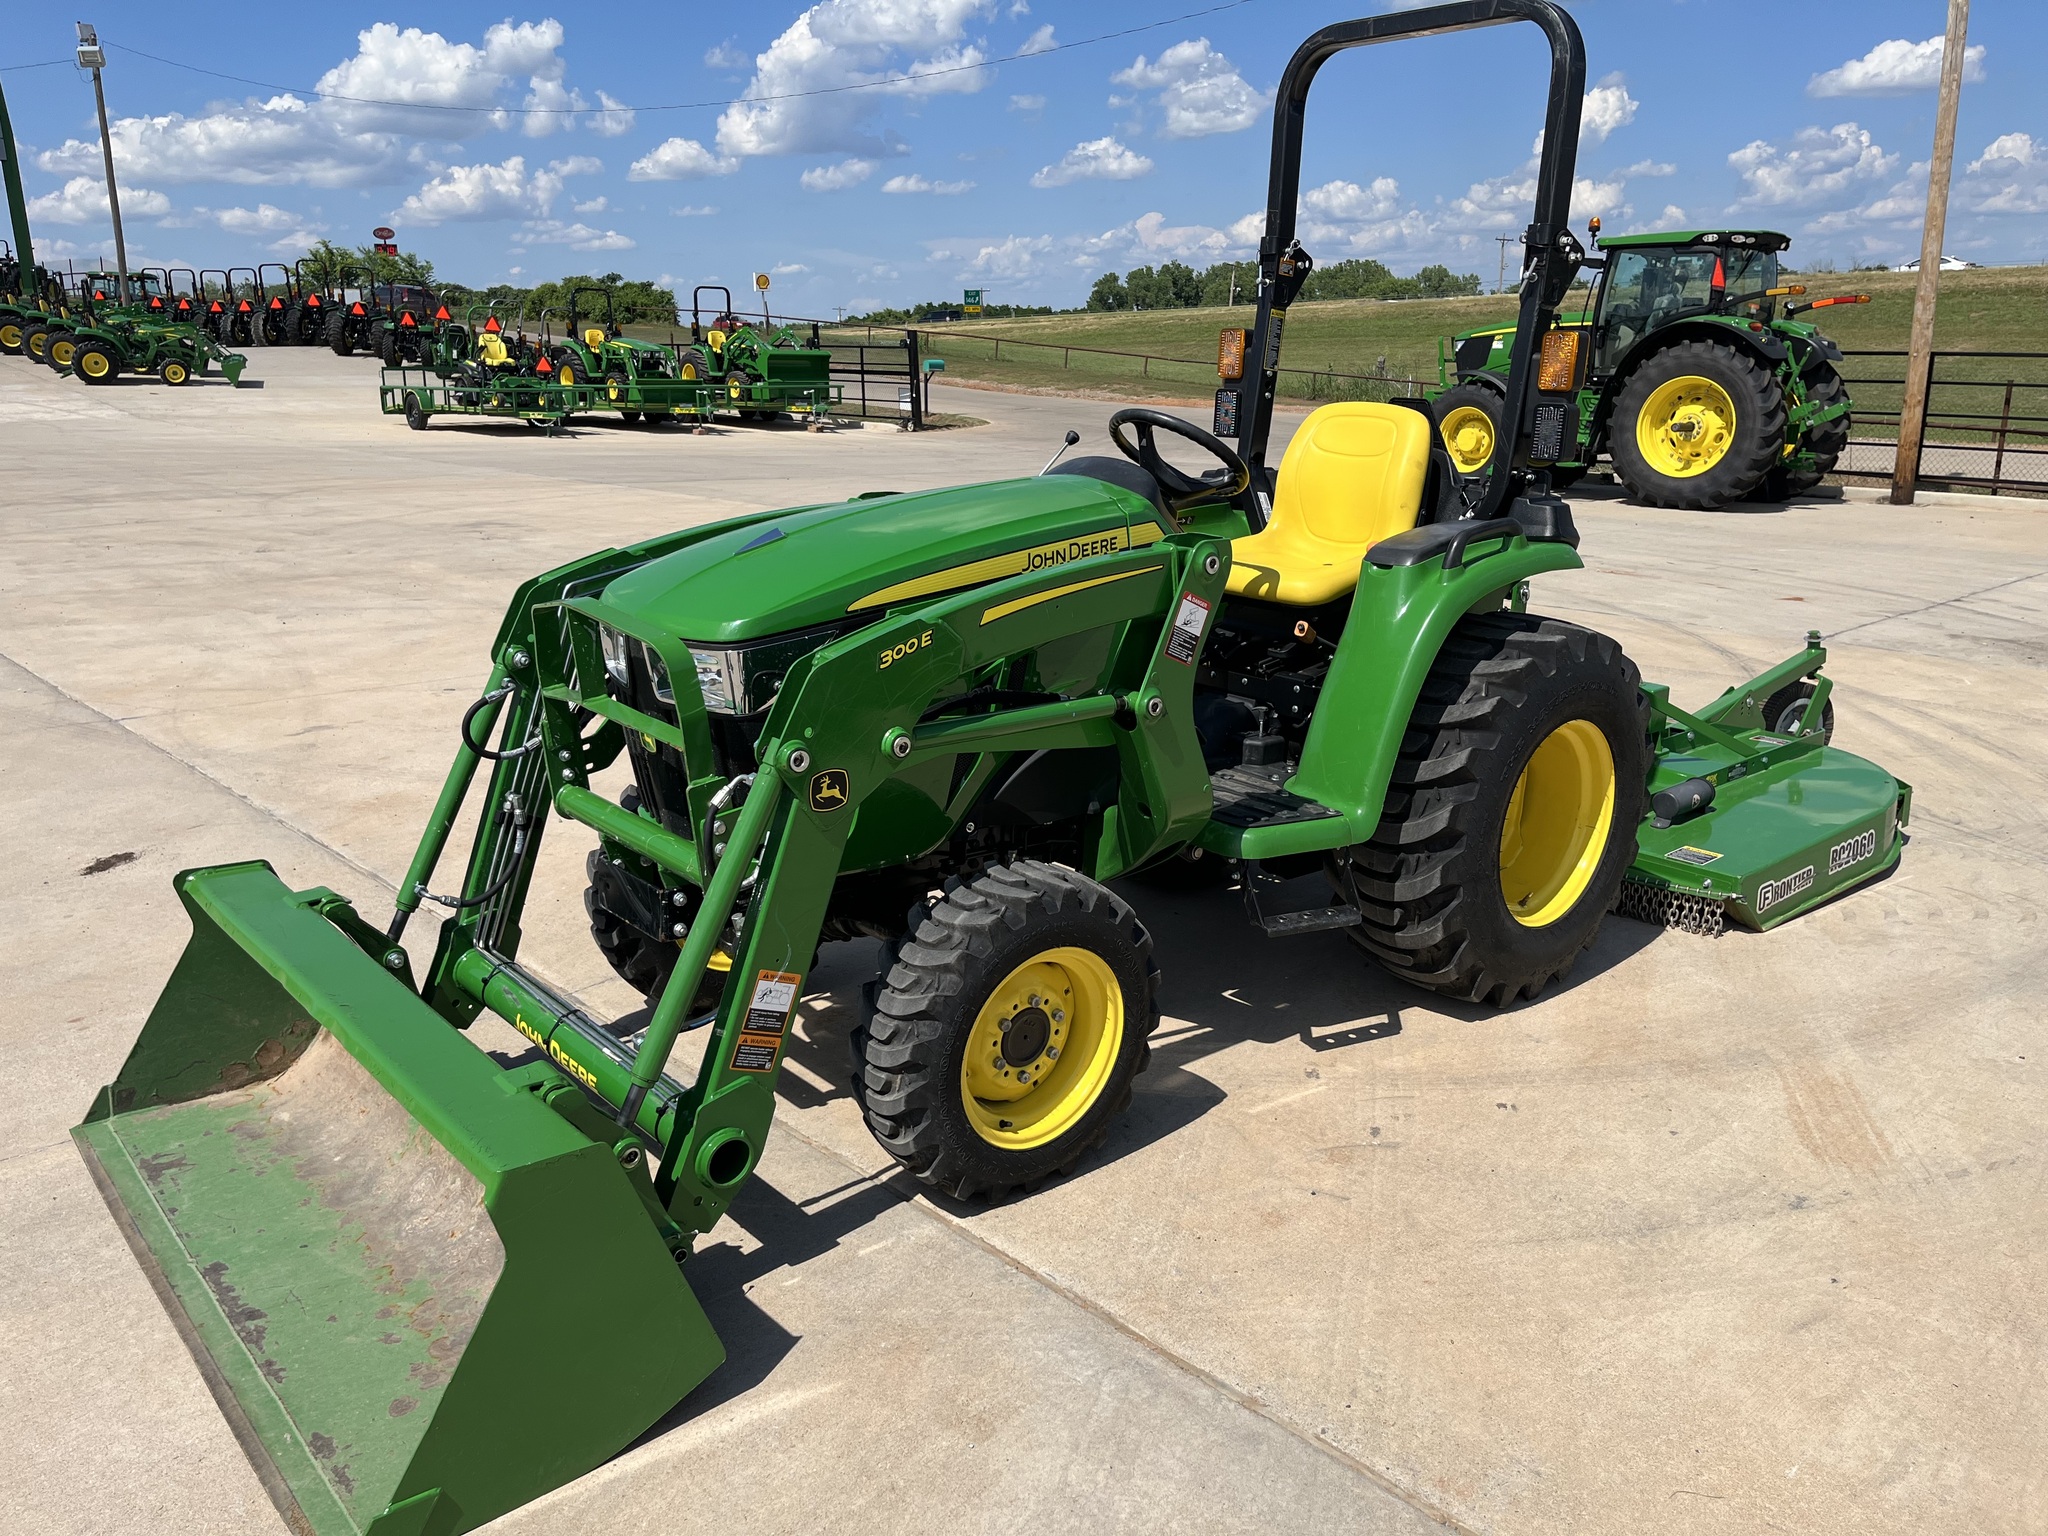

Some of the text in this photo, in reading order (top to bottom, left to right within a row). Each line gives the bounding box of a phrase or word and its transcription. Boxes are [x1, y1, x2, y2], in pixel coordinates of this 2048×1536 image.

[1021, 536, 1118, 572] JOHN DEERE
[1191, 597, 1208, 608] DANGER
[880, 630, 933, 669] 300 E
[1829, 831, 1875, 872] RC2060
[1758, 867, 1813, 912] FRONTIER
[750, 1038, 776, 1046] WARNING
[550, 1039, 597, 1089] DEERE
